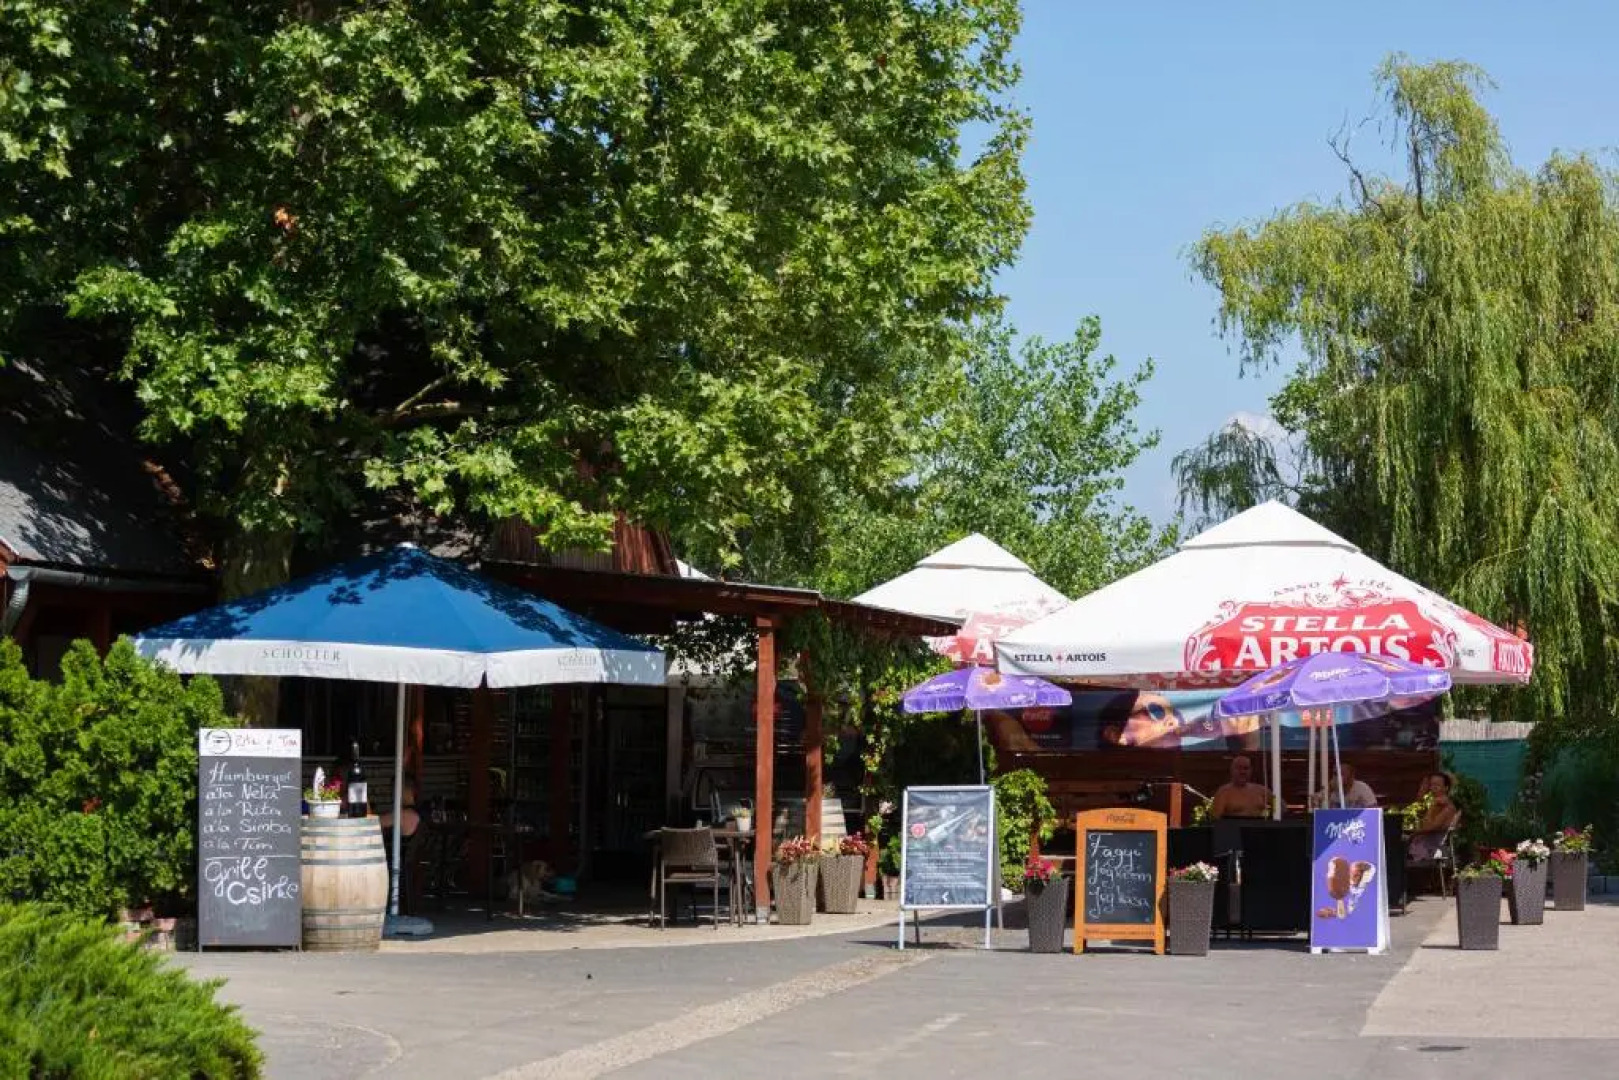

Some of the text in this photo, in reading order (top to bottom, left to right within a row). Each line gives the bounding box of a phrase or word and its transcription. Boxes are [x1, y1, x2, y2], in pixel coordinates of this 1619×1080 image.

[1239, 614, 1412, 632] STELLA
[1014, 652, 1106, 662] STELLA ARTOIS
[1233, 635, 1410, 670] ARTOIS
